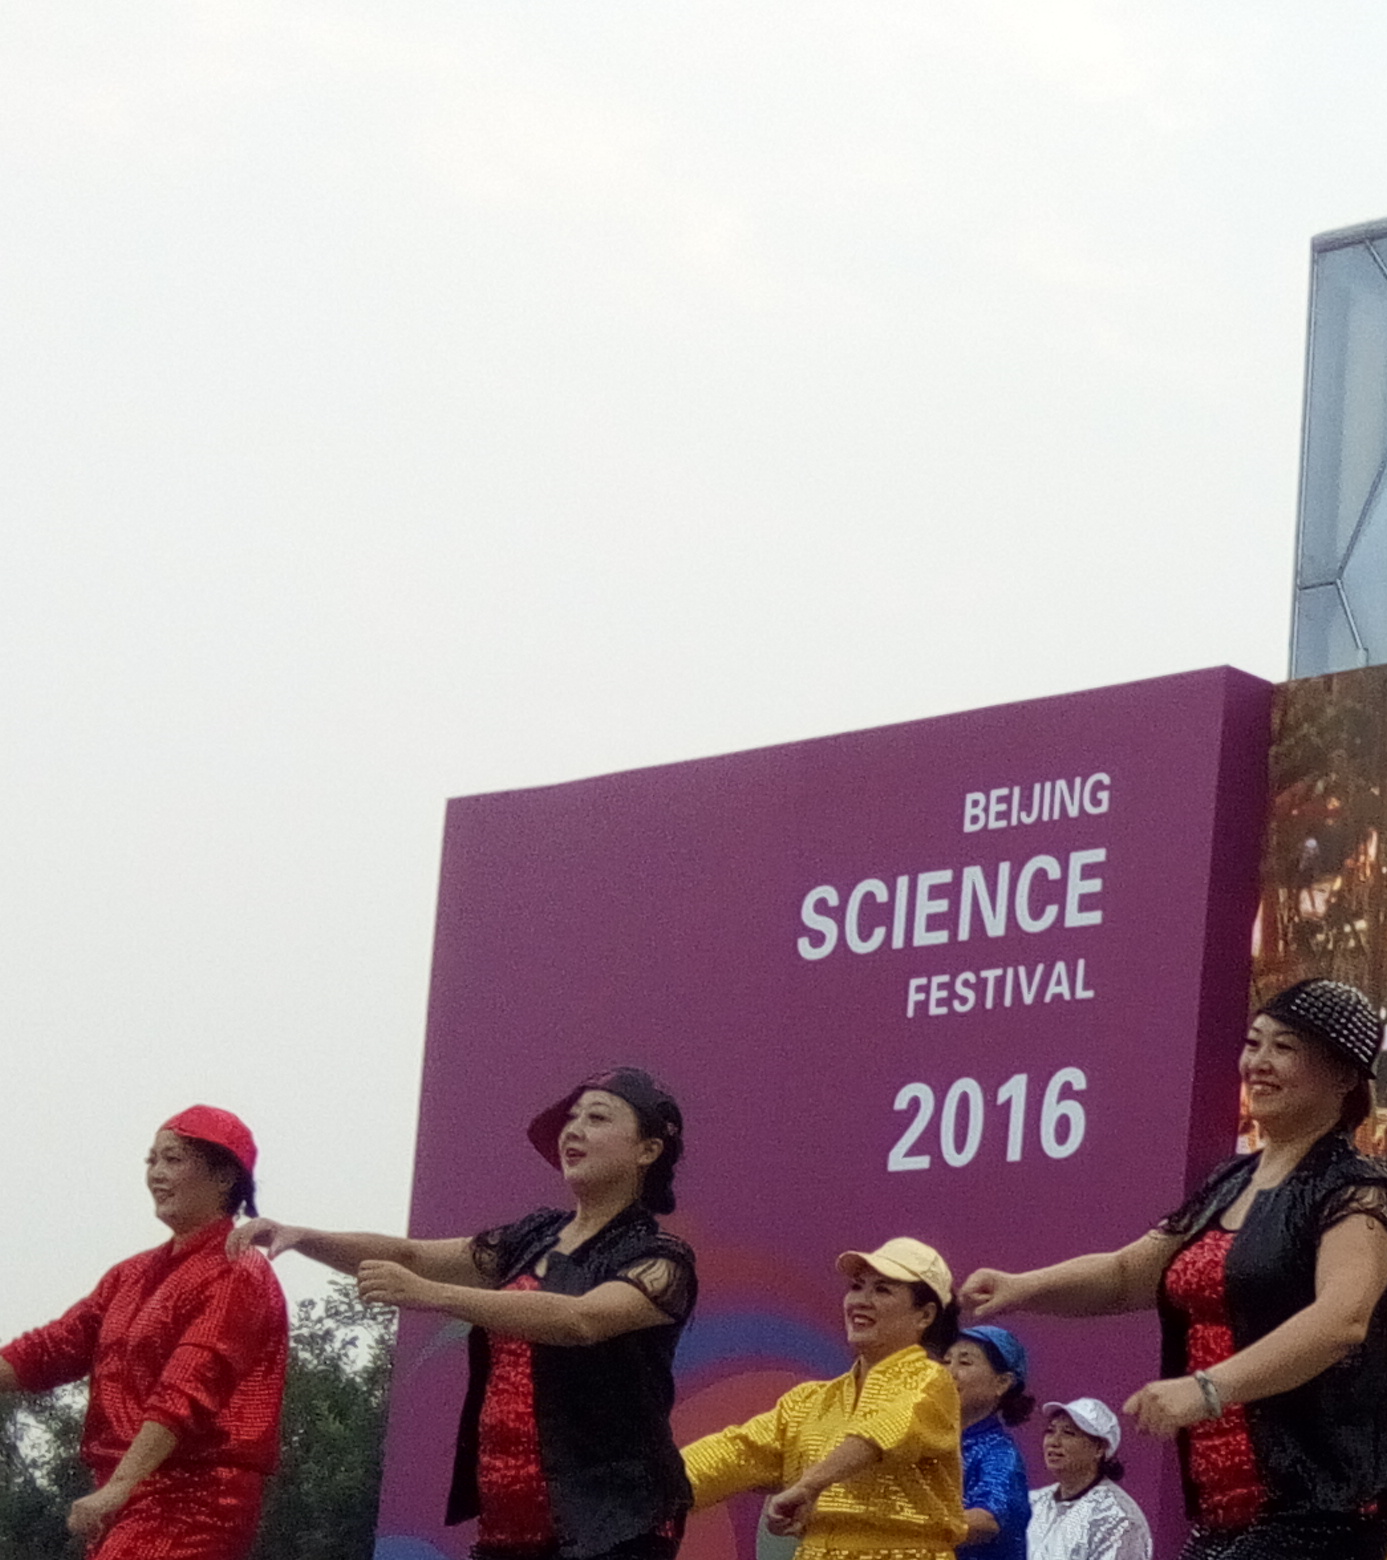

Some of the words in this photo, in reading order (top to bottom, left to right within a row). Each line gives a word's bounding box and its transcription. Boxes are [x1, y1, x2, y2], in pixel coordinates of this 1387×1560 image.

[963, 772, 1111, 833] BEIJING
[797, 848, 1107, 960] SCIENCE
[907, 958, 1095, 1018] FESTIVAL
[887, 1066, 1088, 1172] 2016
